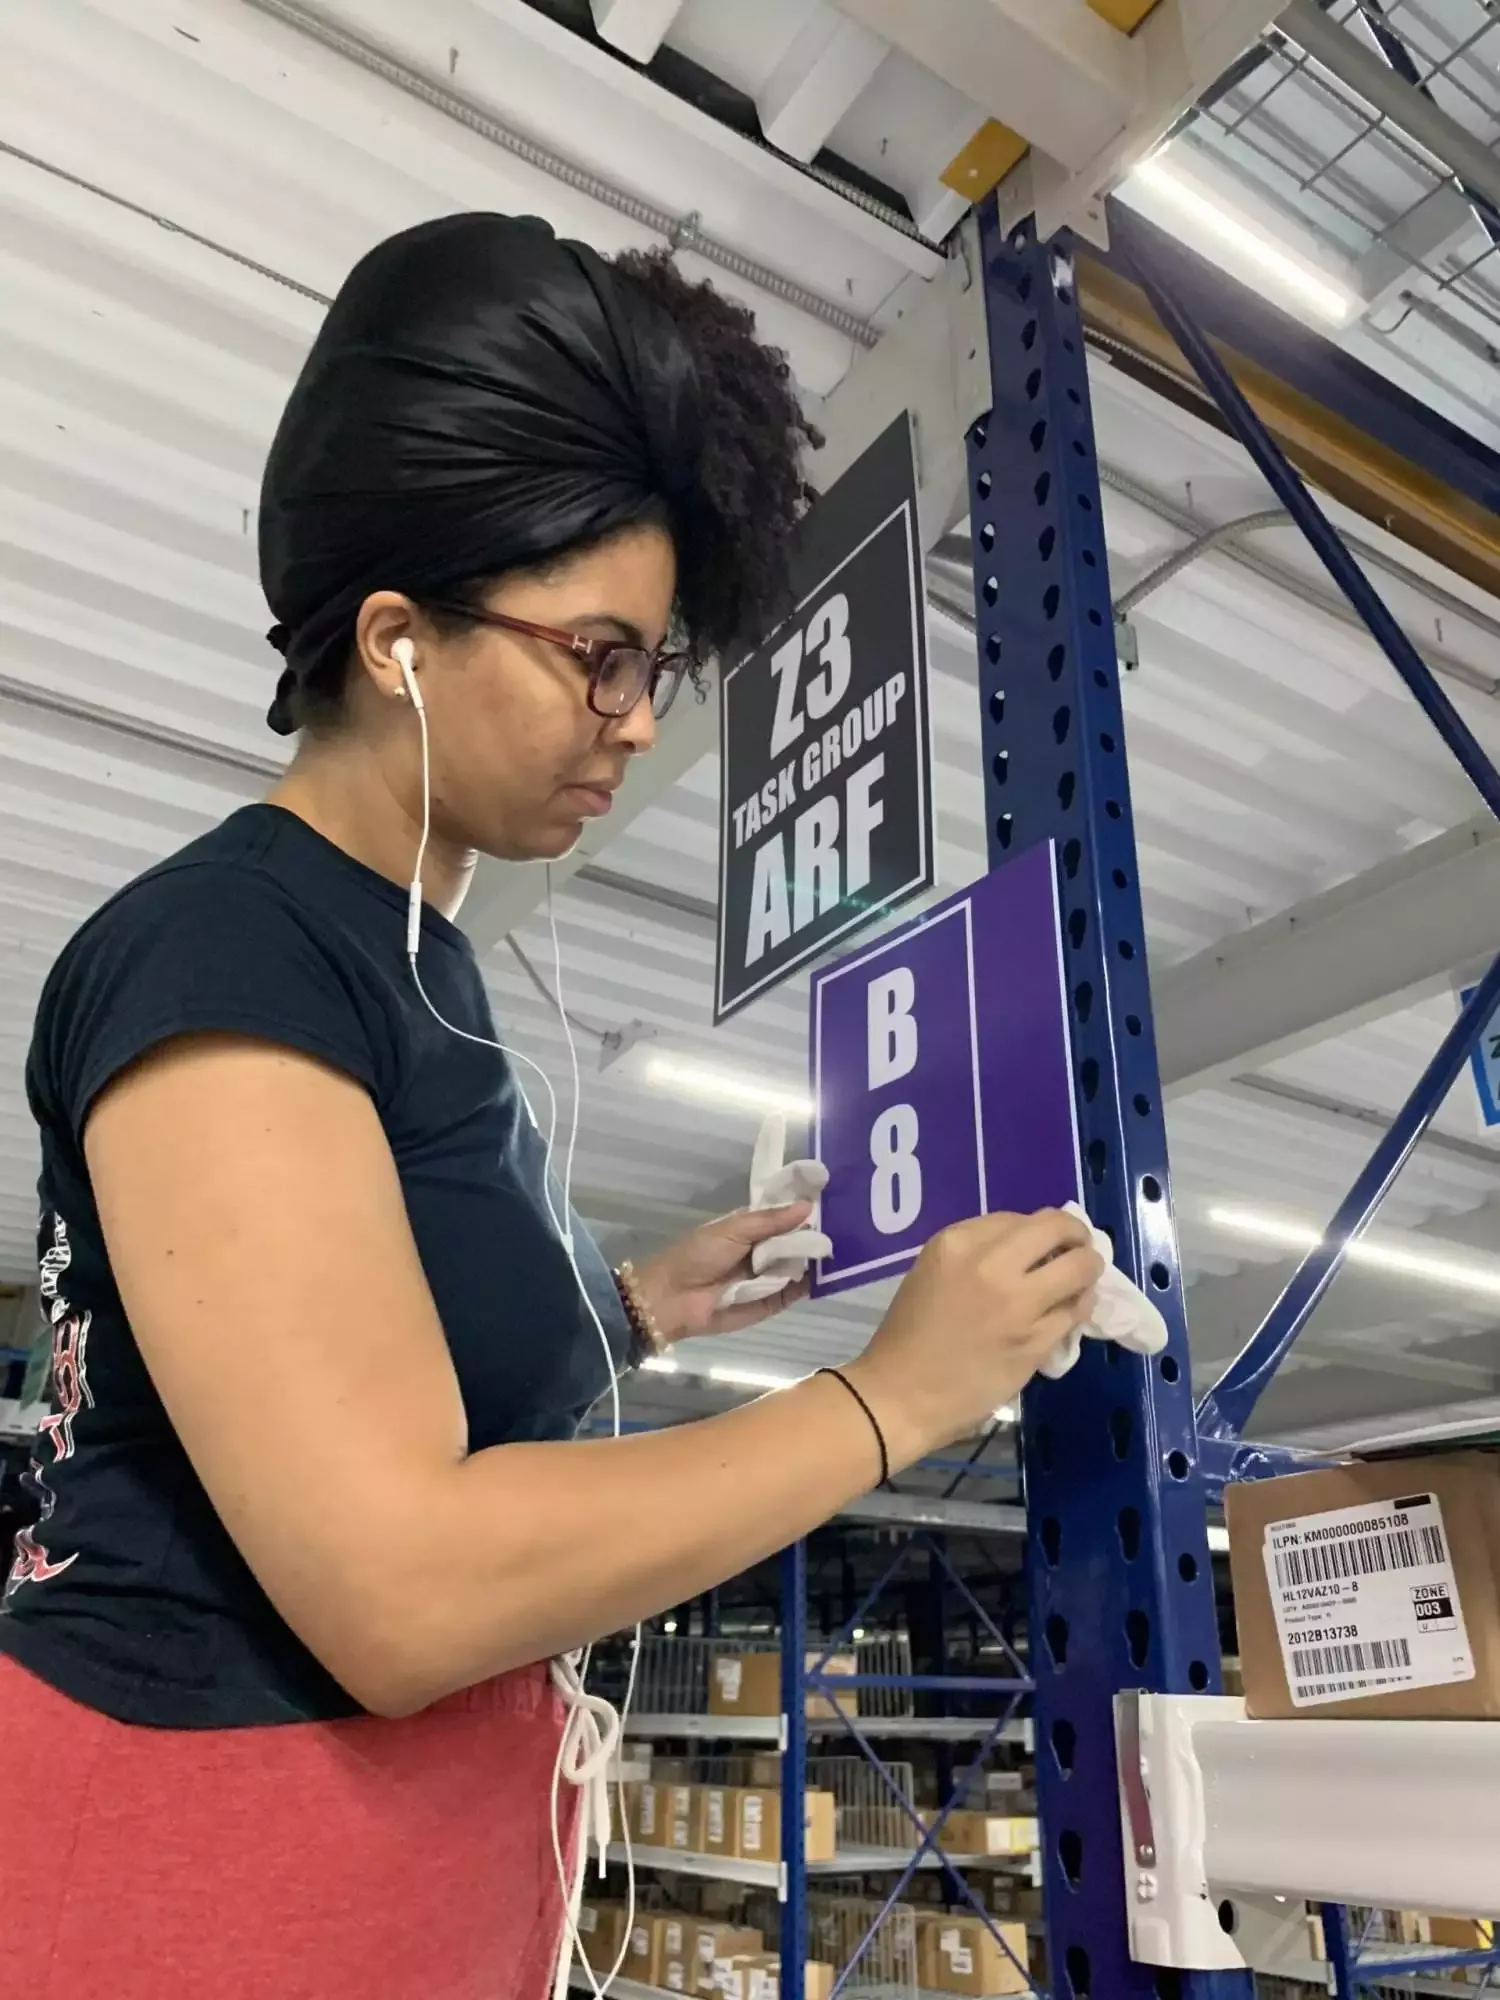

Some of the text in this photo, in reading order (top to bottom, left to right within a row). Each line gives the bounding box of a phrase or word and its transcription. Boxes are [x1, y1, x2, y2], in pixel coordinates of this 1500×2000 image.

[770, 592, 851, 759] Z3
[732, 672, 906, 850] TASK GROUP
[744, 752, 884, 968] ARF
[867, 966, 918, 1091] B
[869, 1103, 922, 1234] 8
[1273, 1533, 1302, 1550] ILPN:
[1414, 1586, 1446, 1599] ZONE
[1416, 1601, 1441, 1617] 003
